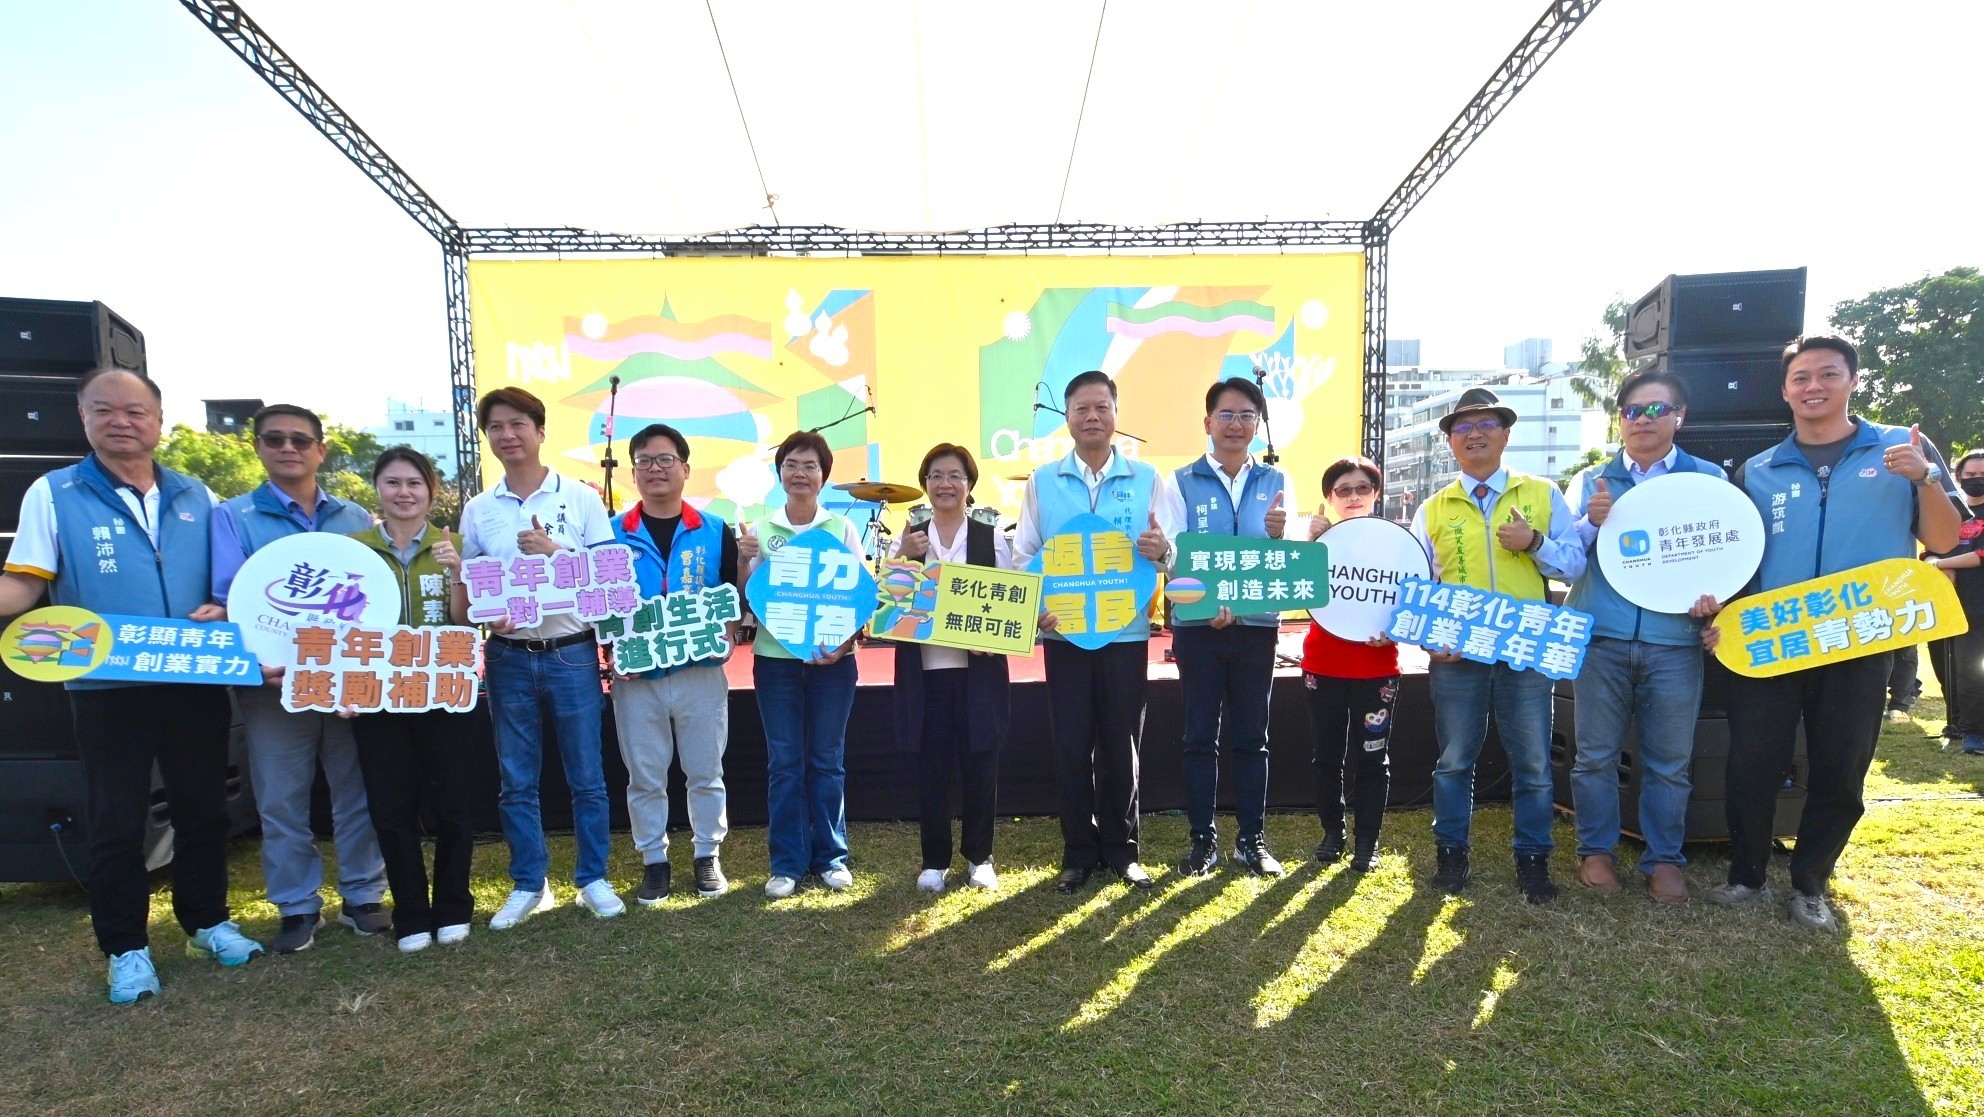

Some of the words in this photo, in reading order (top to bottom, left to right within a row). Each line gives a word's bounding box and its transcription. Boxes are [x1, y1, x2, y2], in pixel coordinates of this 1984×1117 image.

[1658, 519, 1720, 537] 彰化縣政府
[1659, 529, 1741, 552] 青年發展處
[92, 526, 118, 574] 賴沛然
[1041, 531, 1135, 577] 返青
[1661, 550, 1695, 559] DEPARTMENT
[1662, 555, 1699, 565] DEVELOPMENT
[466, 548, 632, 598] 青年創業
[769, 545, 860, 591] 青力
[1052, 580, 1096, 588] CHANGHUA
[1097, 578, 1129, 586] YOUTH!
[1883, 568, 1914, 595] CHANGHUA
[472, 586, 638, 624] 一對一輔導
[776, 591, 820, 599] CHANGHUA
[950, 577, 1027, 604] 彰化青創
[1216, 579, 1315, 601] 創造未來
[1329, 584, 1397, 606] YOUTH
[945, 611, 1022, 639] 無限可能
[1044, 588, 1137, 635] 富民
[1403, 581, 1588, 641] 114彰化青年
[1739, 581, 1874, 636] 美好彰化
[117, 624, 235, 649] 彰顯青年
[292, 626, 477, 668] 青年創業
[616, 621, 726, 672] 進行式
[1390, 609, 1579, 675] 創業嘉年華
[1745, 599, 1937, 668] 宜居青勢力
[133, 651, 250, 676] 創業實力
[291, 669, 473, 709] 獎勵補助
